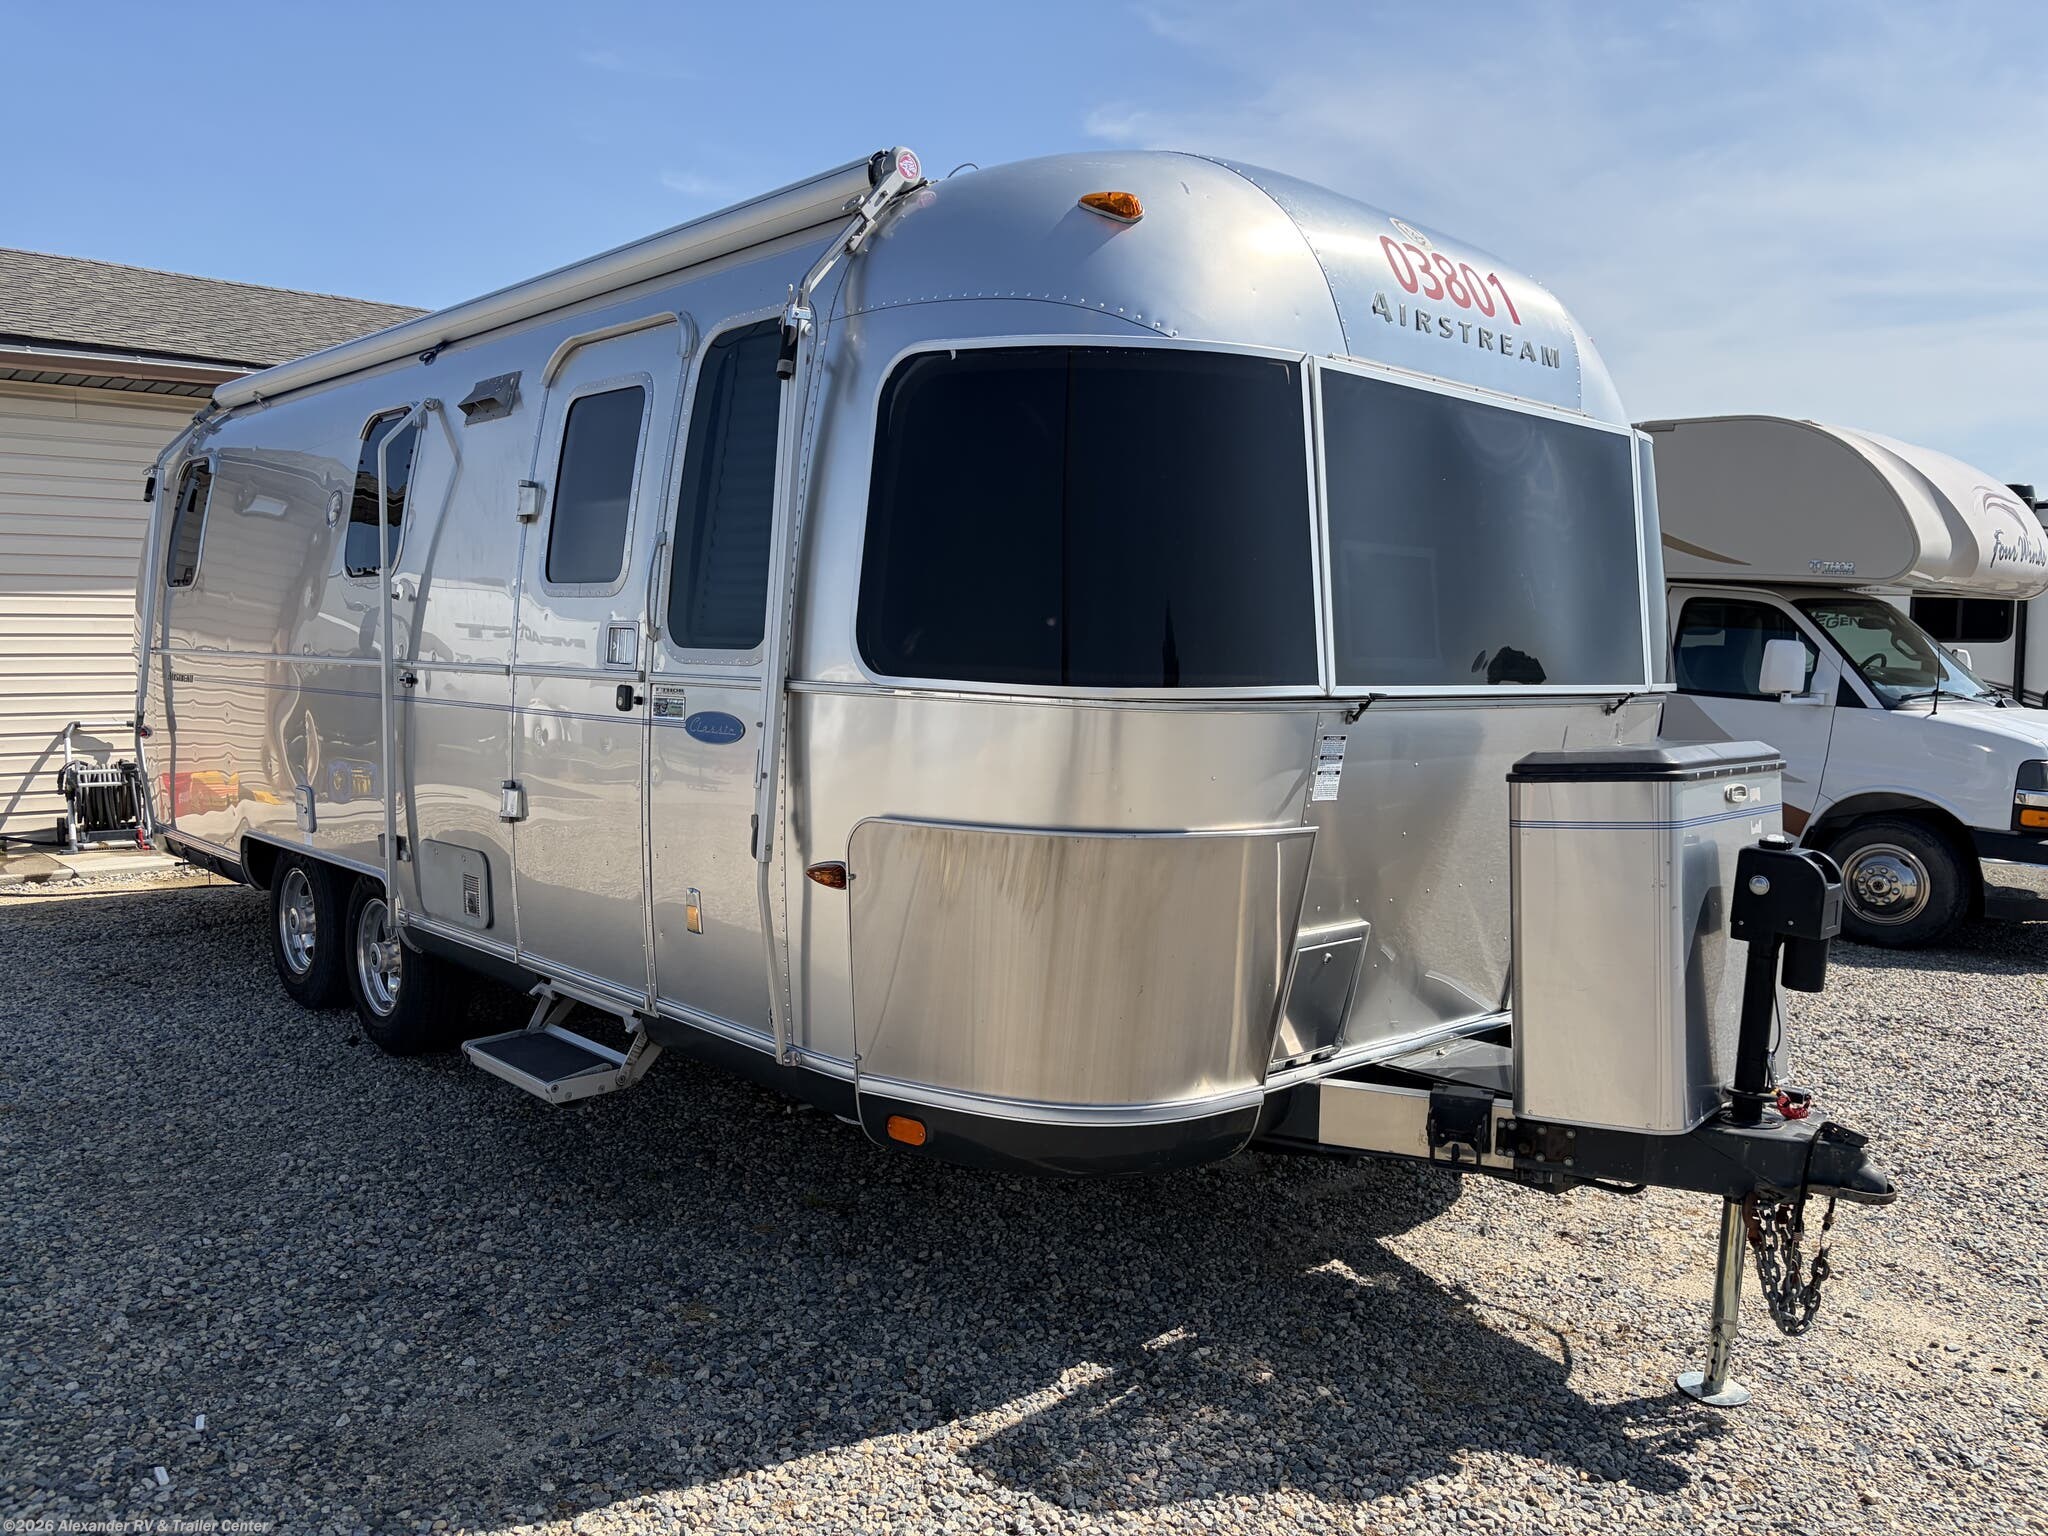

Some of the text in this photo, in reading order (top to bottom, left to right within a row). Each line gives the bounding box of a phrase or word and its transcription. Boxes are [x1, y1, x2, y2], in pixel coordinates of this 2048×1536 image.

[1379, 235, 1521, 325] 03801
[1372, 289, 1560, 368] AIRSTREAM
[1823, 561, 1856, 572] THOR
[1990, 529, 2018, 568] Four
